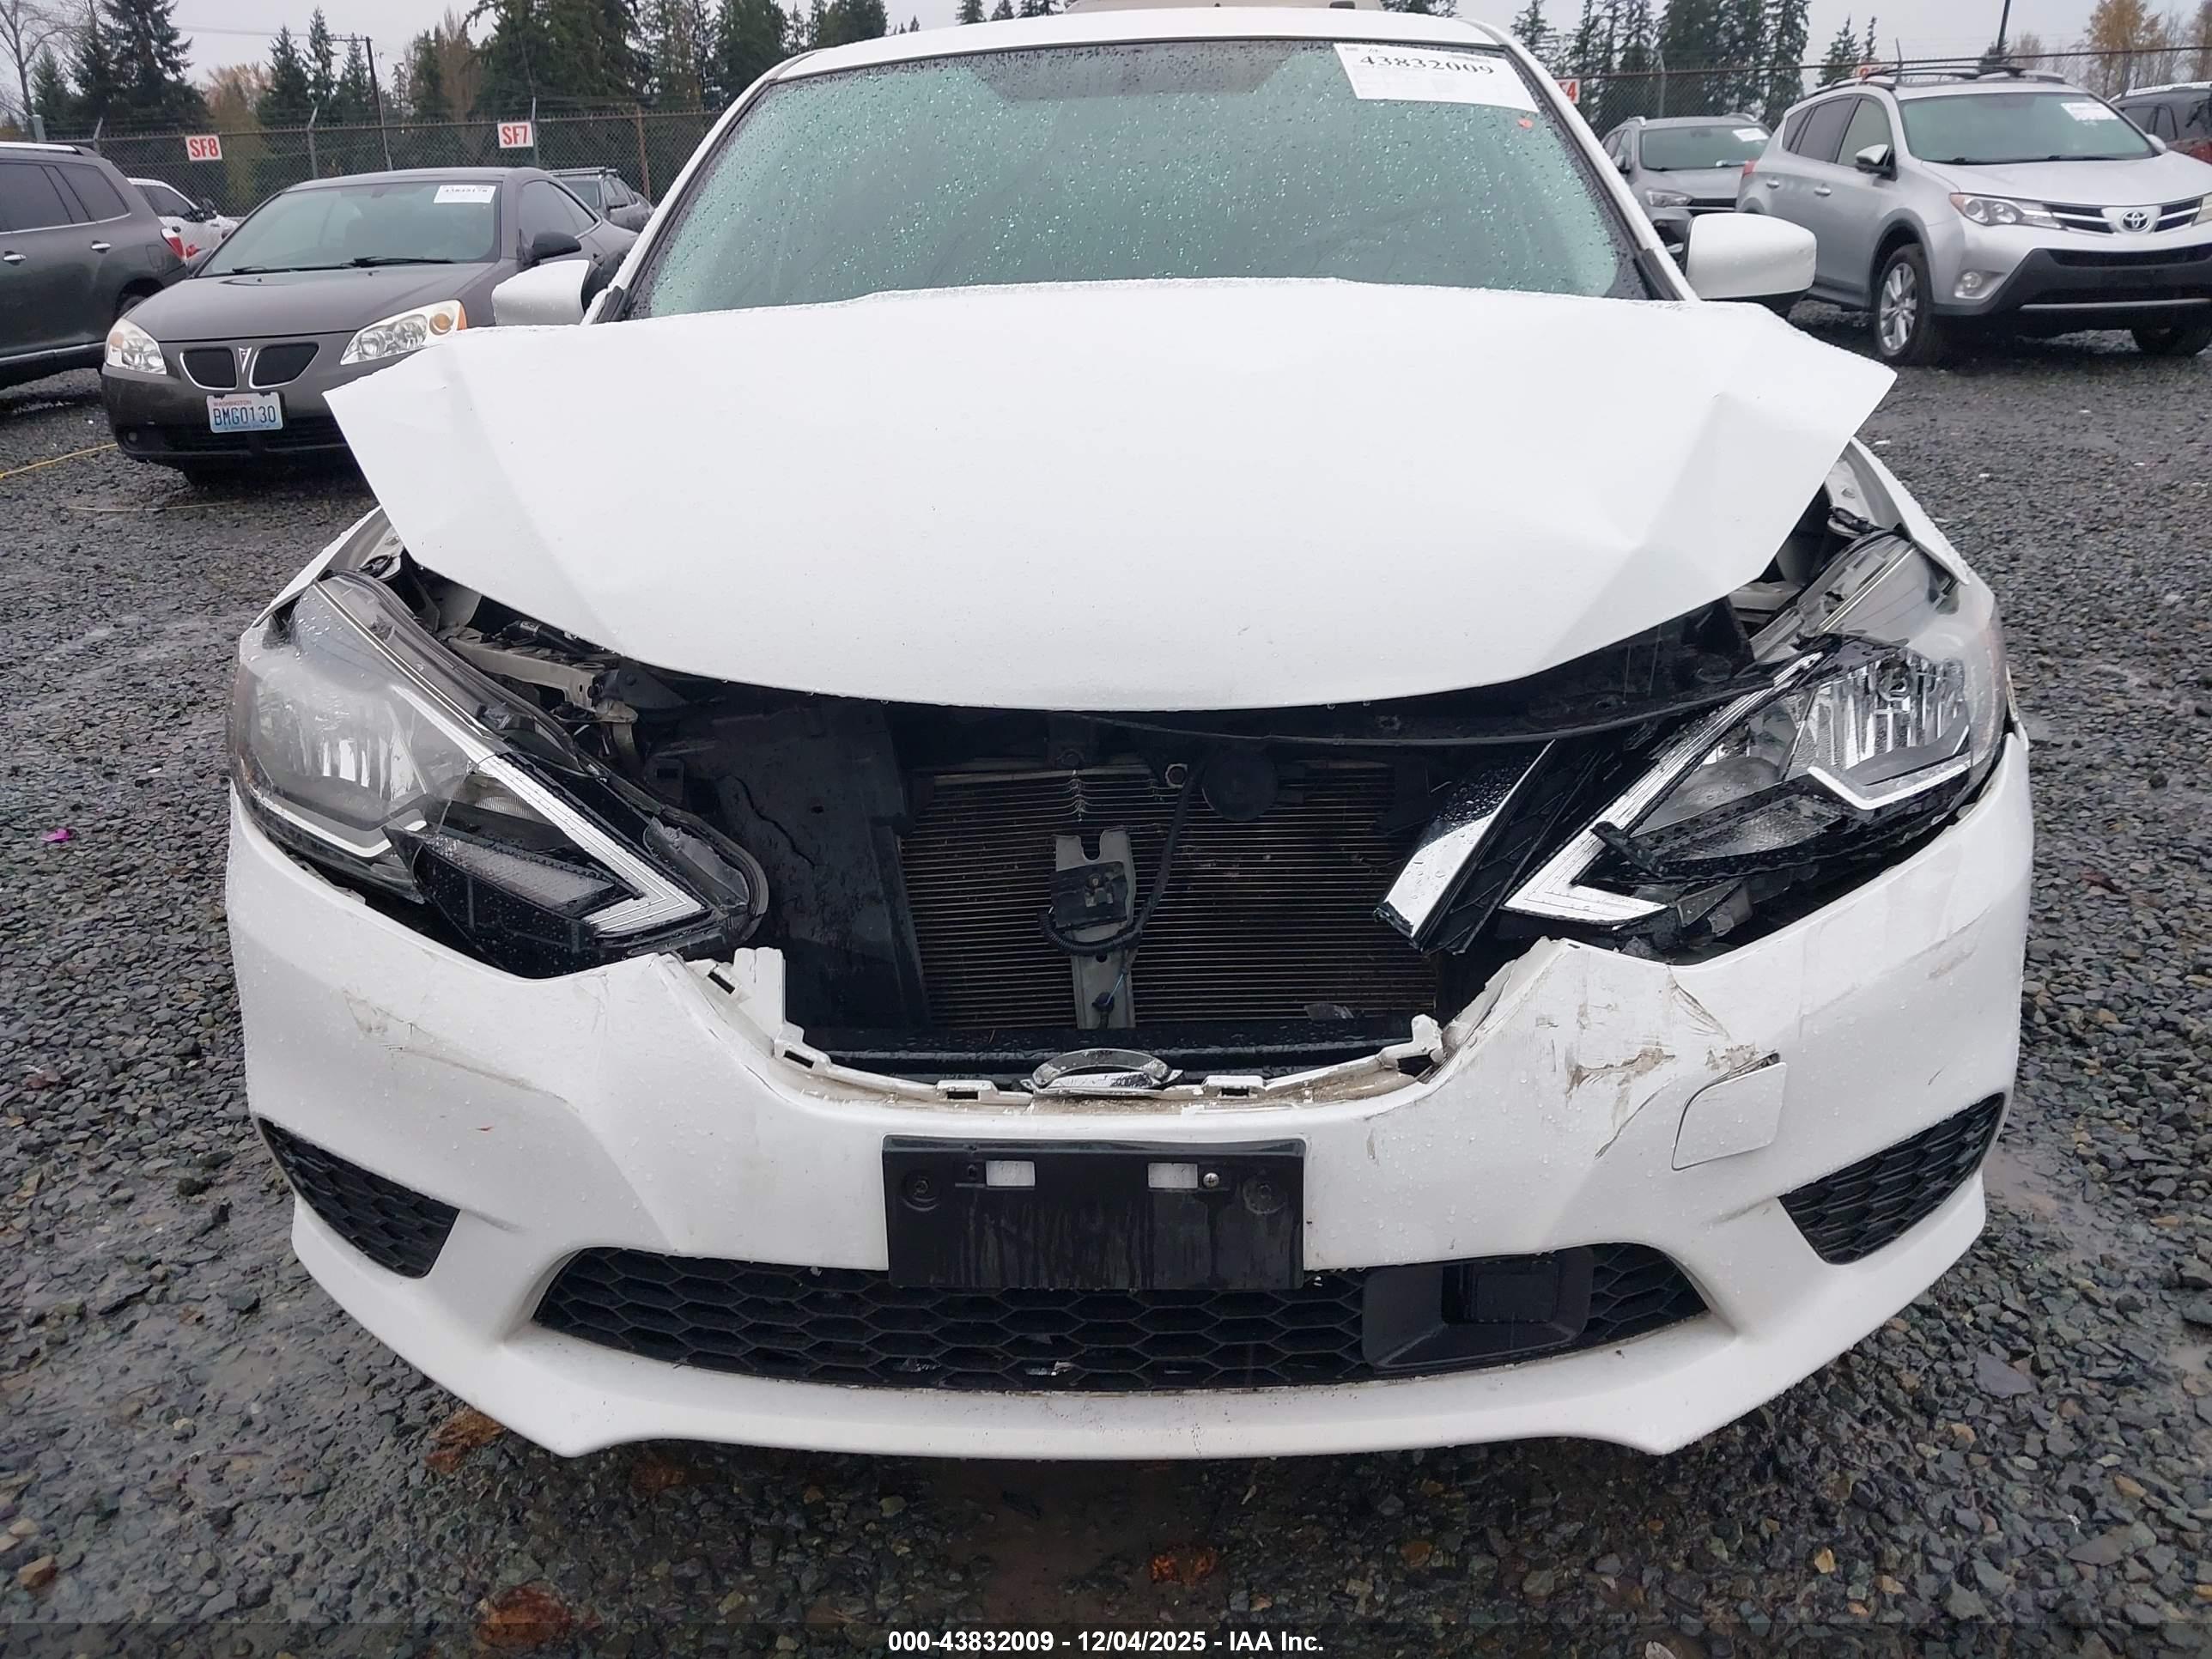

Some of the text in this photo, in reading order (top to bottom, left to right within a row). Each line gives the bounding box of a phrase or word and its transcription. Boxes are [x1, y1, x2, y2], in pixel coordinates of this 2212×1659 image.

[1360, 55, 1494, 75] 43832009
[501, 125, 528, 145] SF7
[189, 137, 219, 158] SF8
